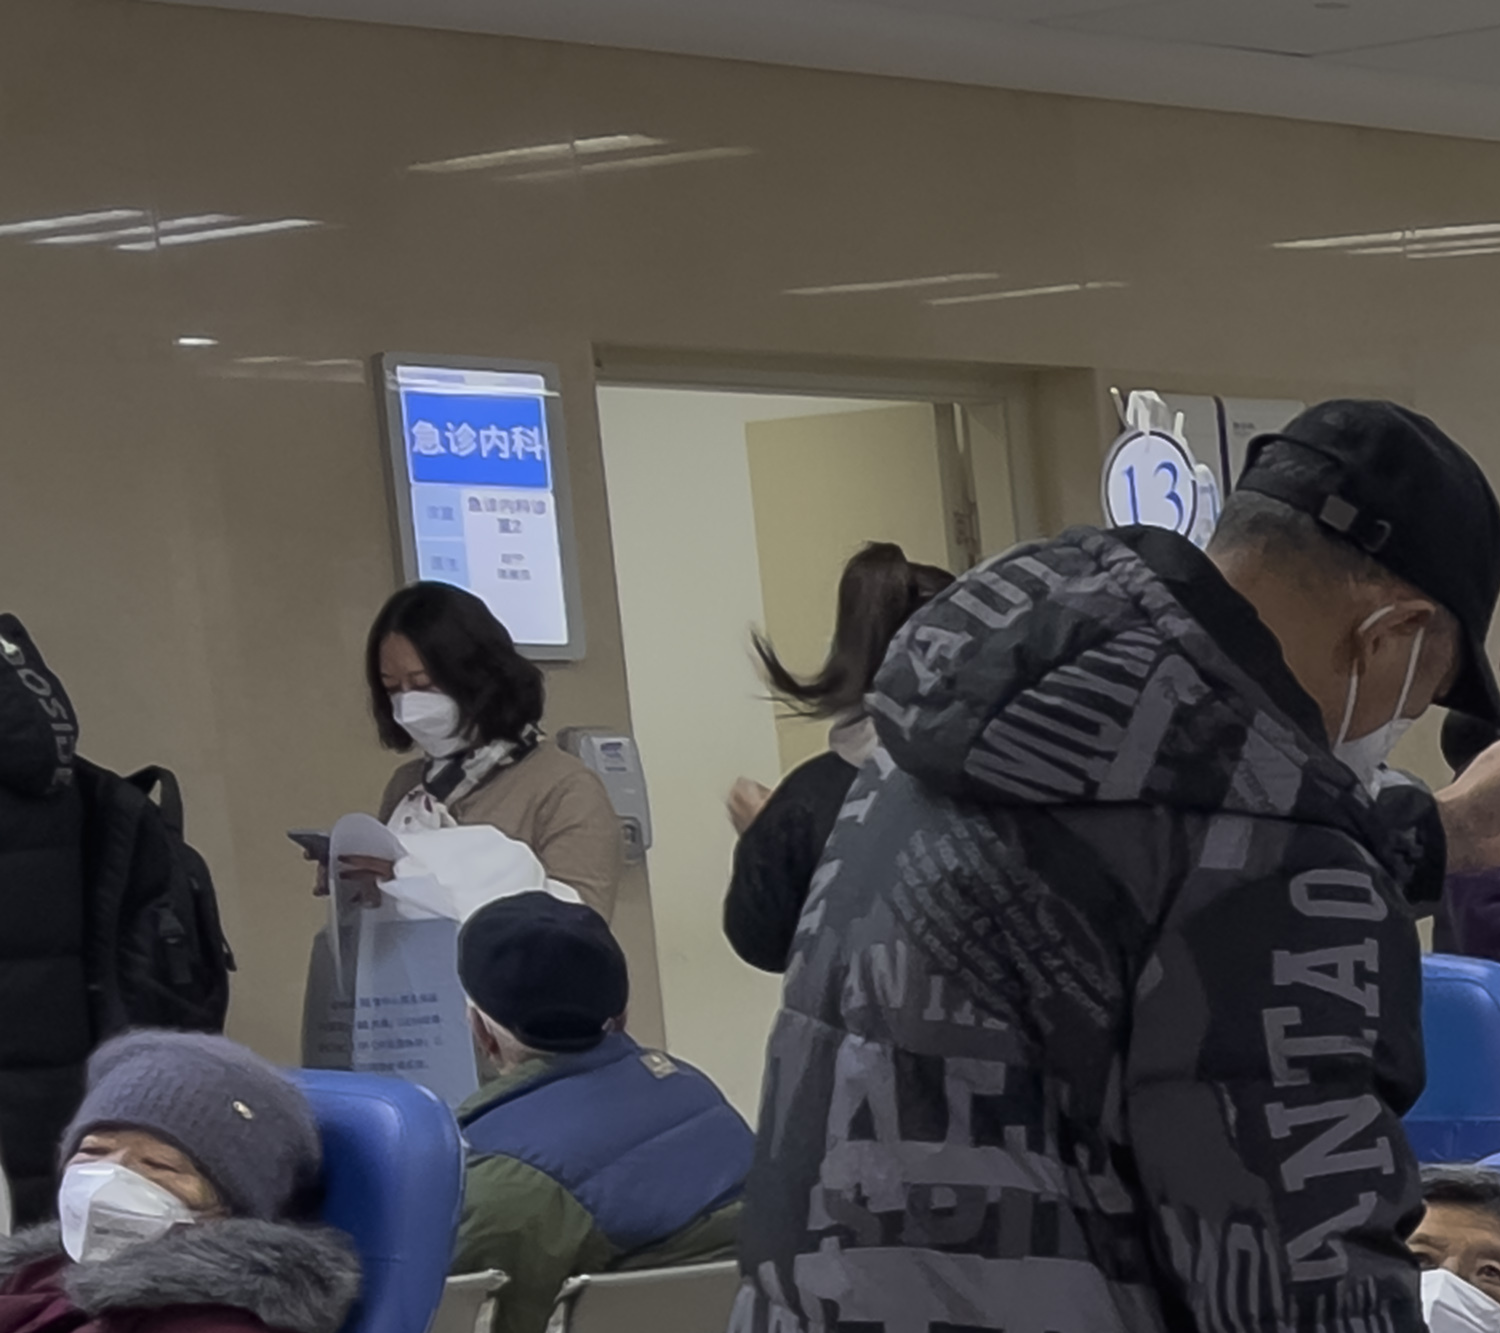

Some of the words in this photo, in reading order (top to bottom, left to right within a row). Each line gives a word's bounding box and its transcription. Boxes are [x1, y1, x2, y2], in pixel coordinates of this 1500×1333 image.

[411, 420, 546, 461] 急诊内科
[1122, 461, 1184, 531] 13
